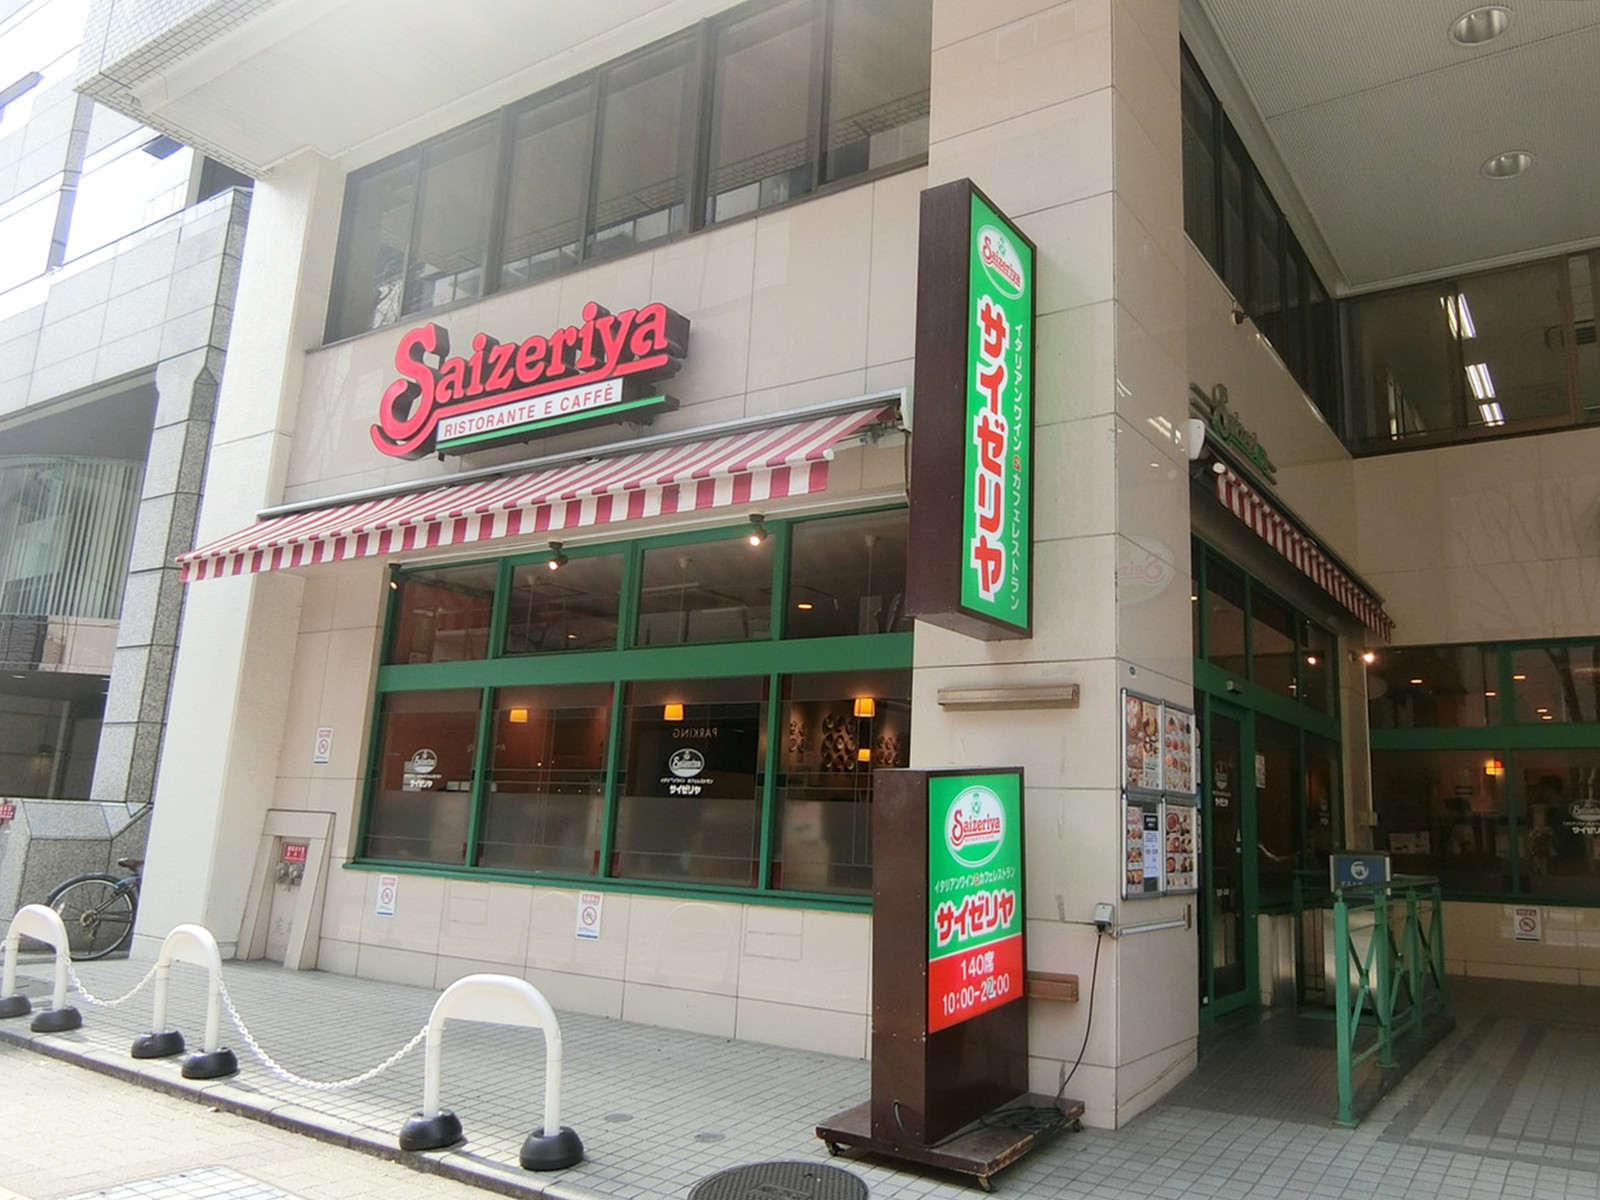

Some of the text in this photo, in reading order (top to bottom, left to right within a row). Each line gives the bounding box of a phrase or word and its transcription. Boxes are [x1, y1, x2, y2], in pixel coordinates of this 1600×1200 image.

[370, 301, 670, 457] Saizeriya
[443, 384, 614, 438] RISTORANTE E CAFFÈ
[973, 301, 1009, 596] サイゼリヤ
[951, 809, 1001, 847] Saizeriya
[935, 888, 1015, 945] サイゼリヤ
